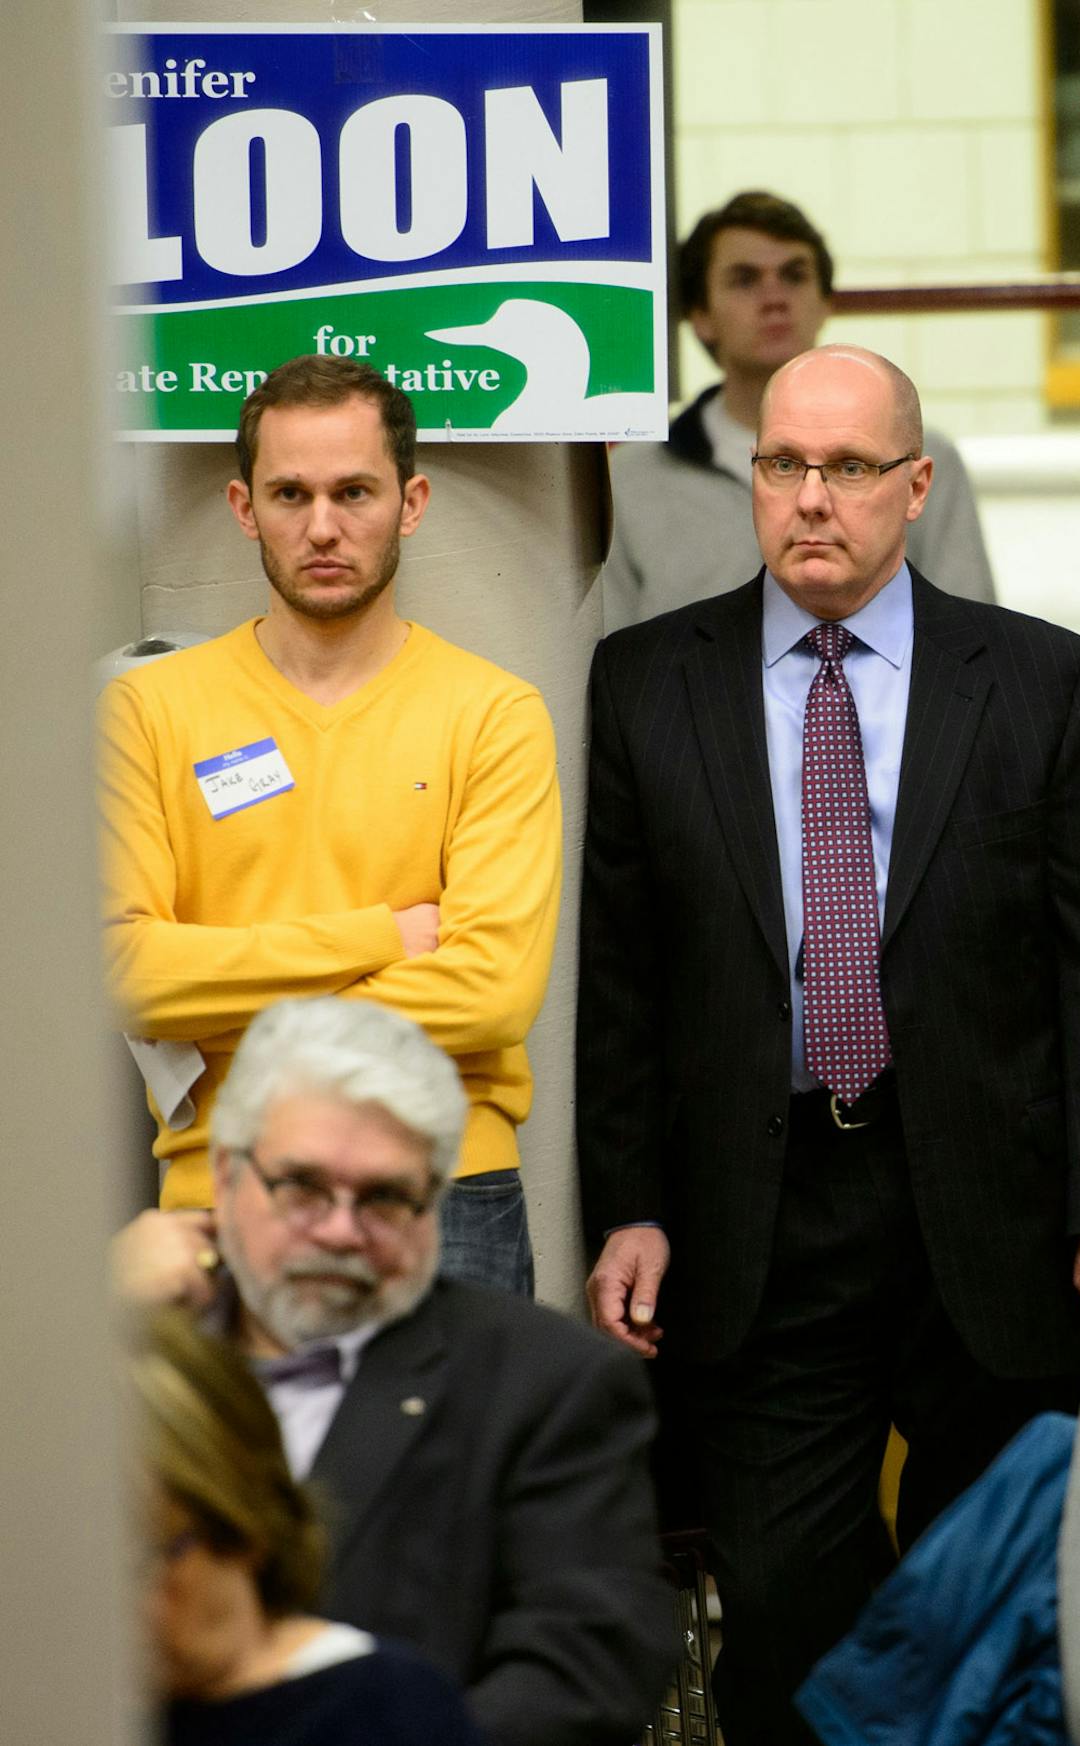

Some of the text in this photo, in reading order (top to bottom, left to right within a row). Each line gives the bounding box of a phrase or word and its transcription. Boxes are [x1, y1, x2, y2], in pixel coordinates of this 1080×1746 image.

[103, 58, 256, 99] enifer
[103, 78, 610, 286] LOON
[313, 325, 377, 357] for
[116, 359, 501, 400] ate Reptative
